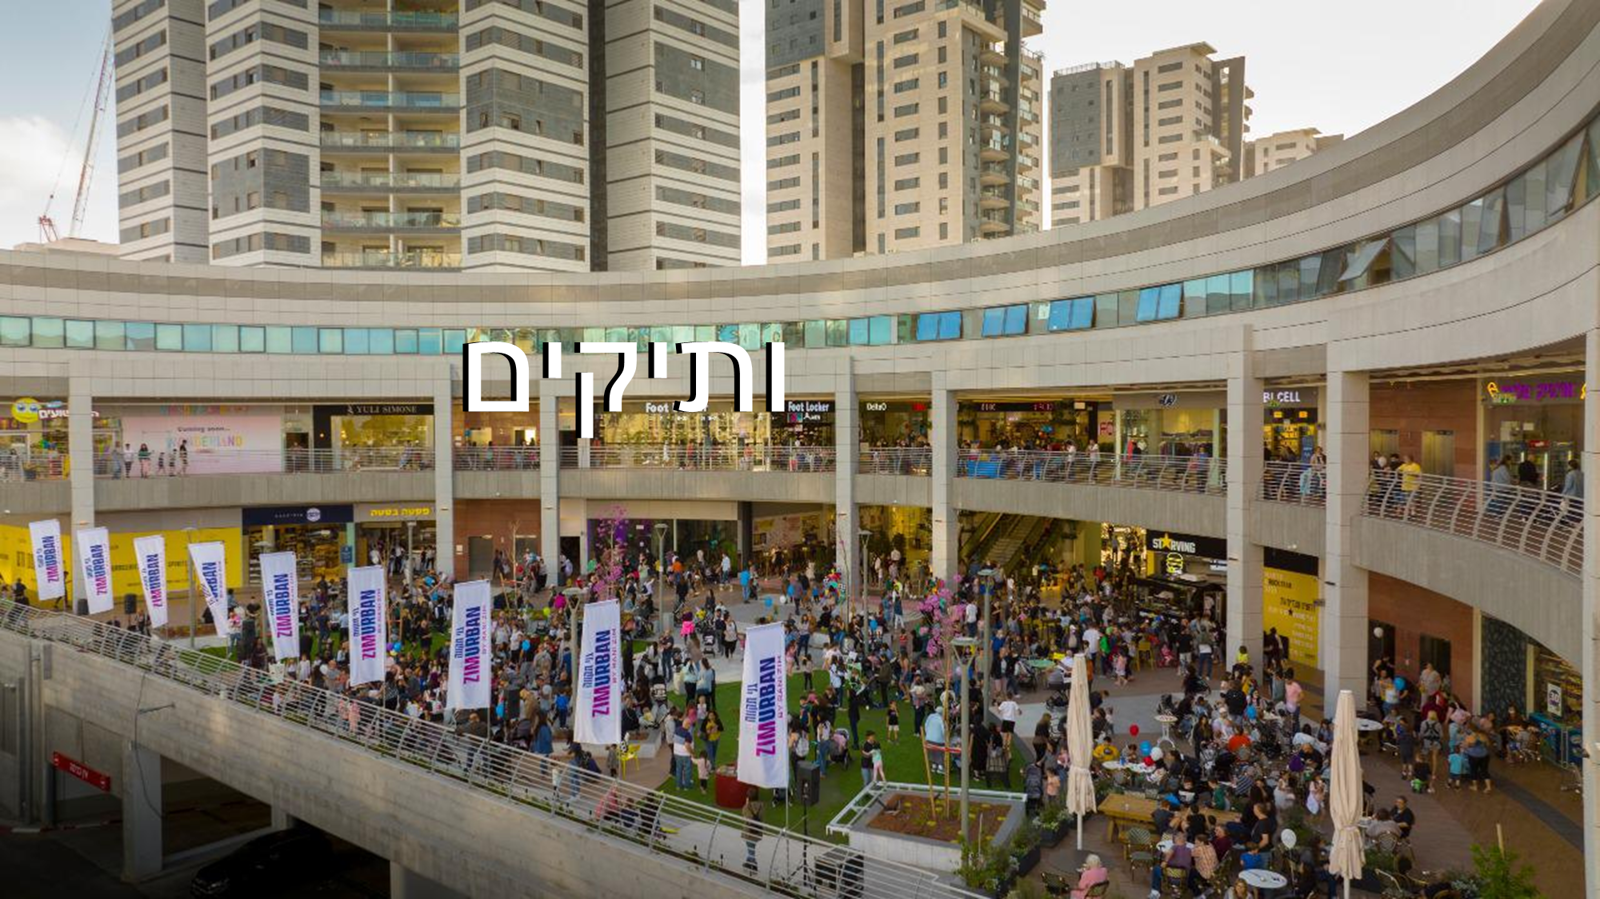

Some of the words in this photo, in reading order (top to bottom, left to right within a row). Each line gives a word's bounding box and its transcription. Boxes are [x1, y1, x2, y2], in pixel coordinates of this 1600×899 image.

[39, 409, 100, 419] השועים
[357, 405, 380, 414] YULI
[382, 405, 418, 414] SIMONE
[645, 402, 669, 413] Foot
[788, 401, 804, 412] Foot
[805, 401, 830, 412] Locker
[1277, 391, 1301, 403] CELL
[42, 536, 59, 583] ZIMURBAN
[90, 544, 107, 595] ZIMURBAN
[146, 554, 163, 607] ZIMURBAN
[273, 573, 293, 638] ZIMURBAN
[360, 589, 376, 660] ZIMURBAN
[463, 606, 480, 684] ZIMURBAN
[592, 629, 611, 718] ZIMURBAN
[747, 683, 758, 695] גני
[755, 656, 776, 757] ZIMURBAN
